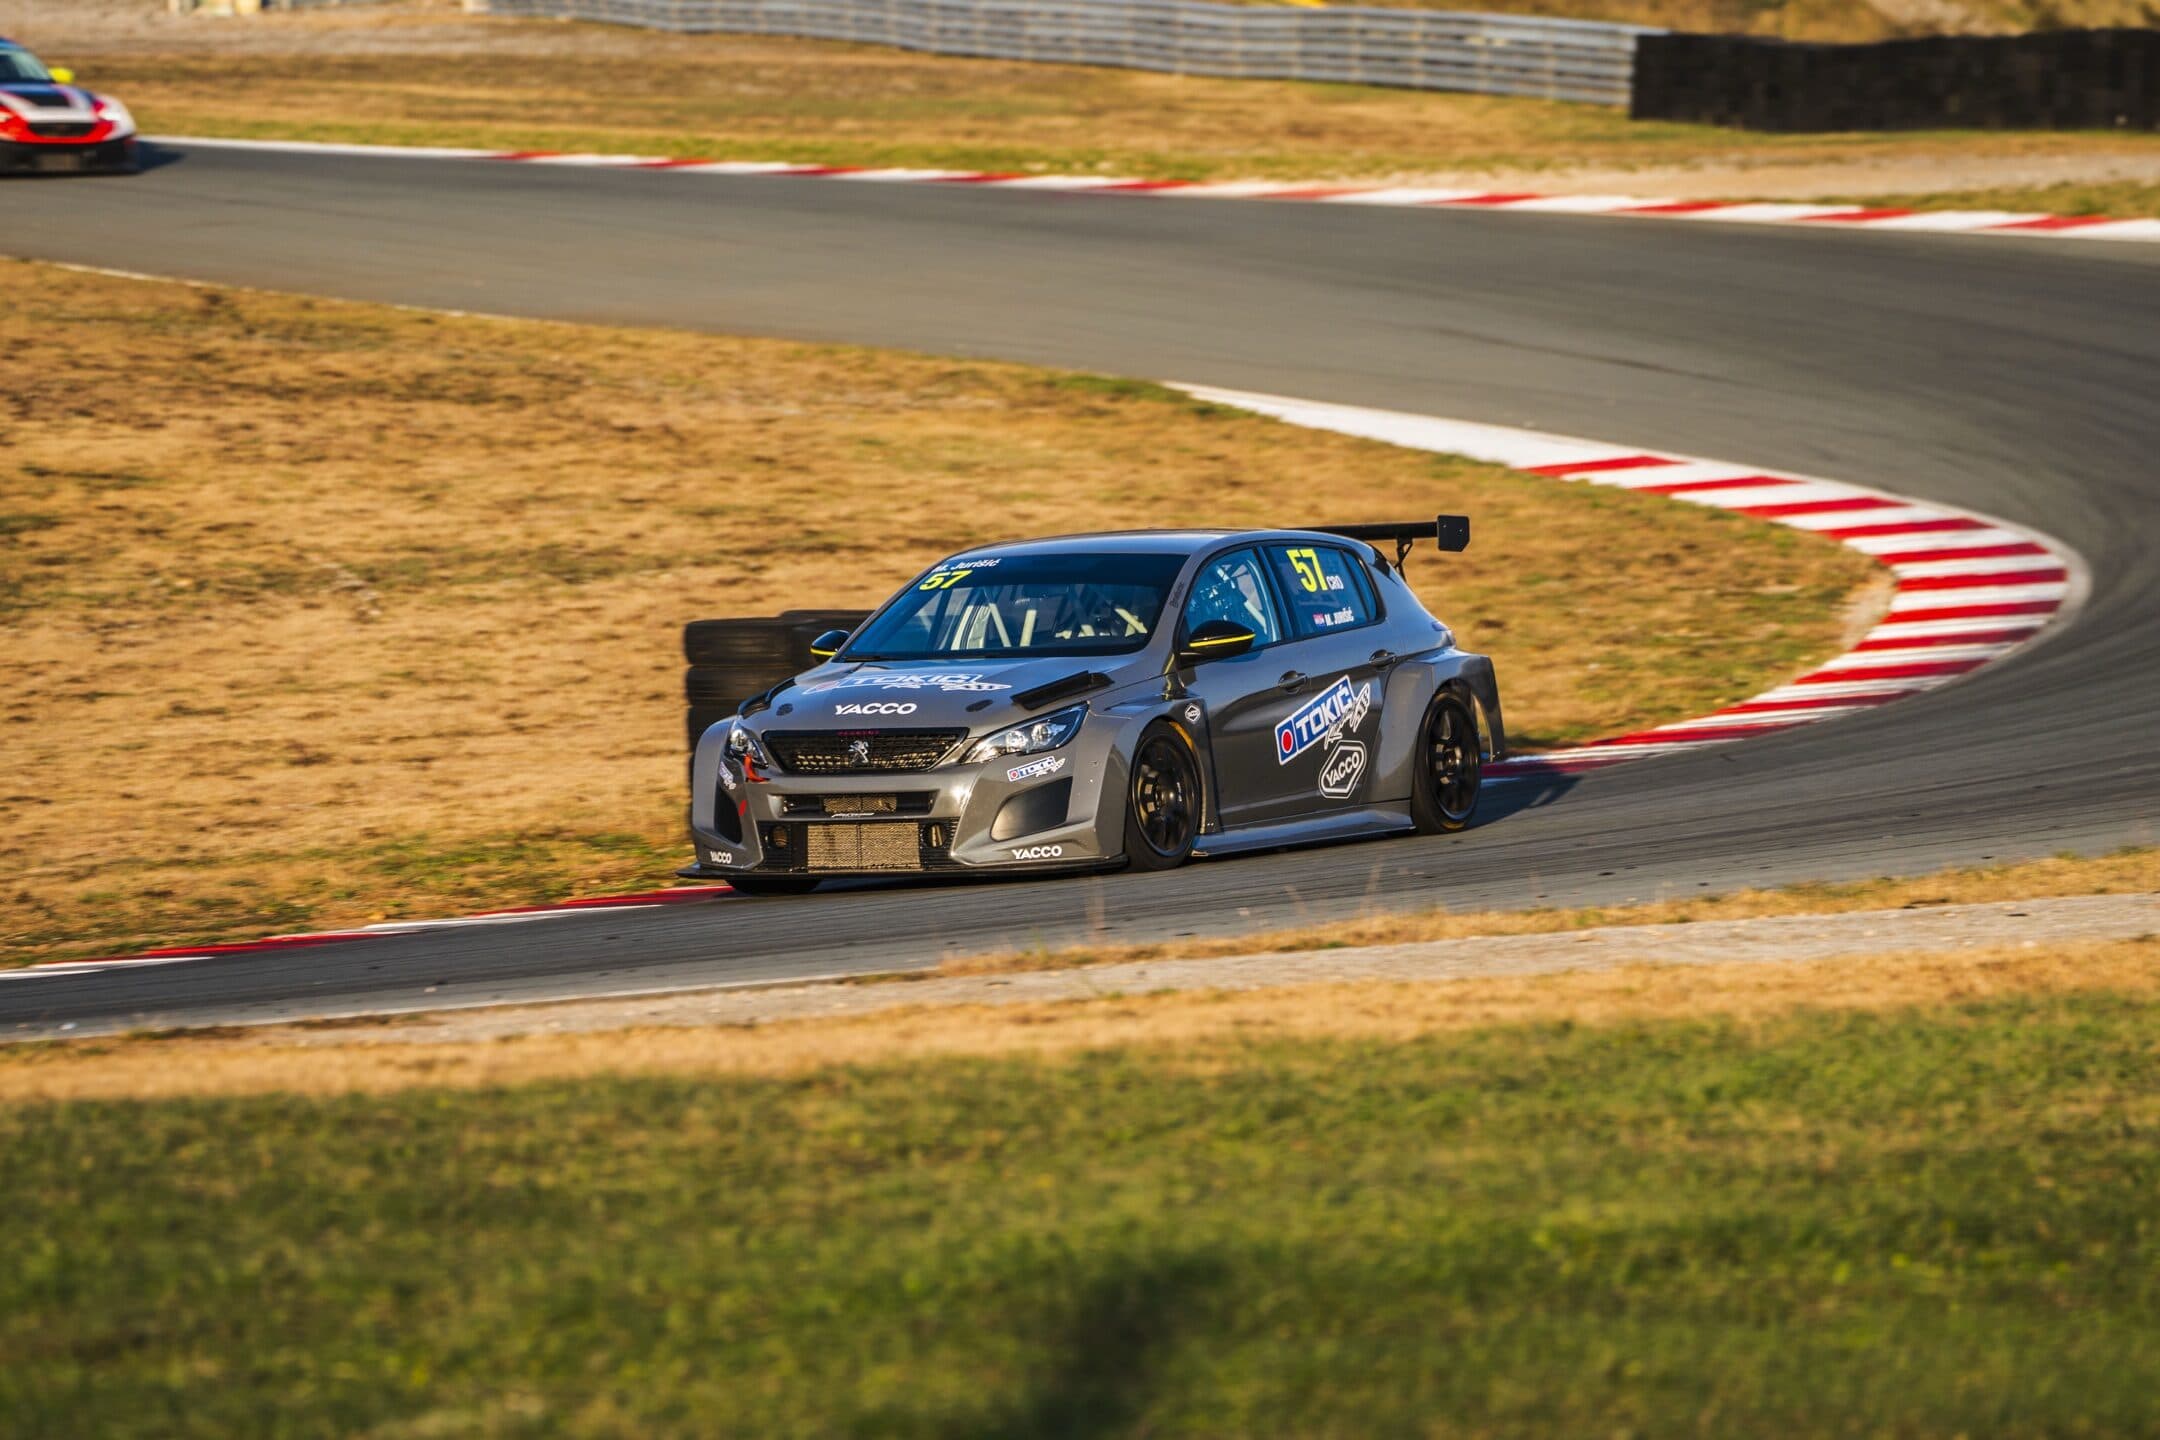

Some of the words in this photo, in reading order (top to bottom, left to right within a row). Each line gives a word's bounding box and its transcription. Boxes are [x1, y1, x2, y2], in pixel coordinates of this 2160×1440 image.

[919, 570, 973, 591] 57
[1286, 549, 1328, 592] 57
[835, 702, 918, 715] YACCO
[1295, 684, 1352, 742] TOKIĆ
[1326, 752, 1360, 787] YACCO
[1011, 845, 1062, 860] YACCO
